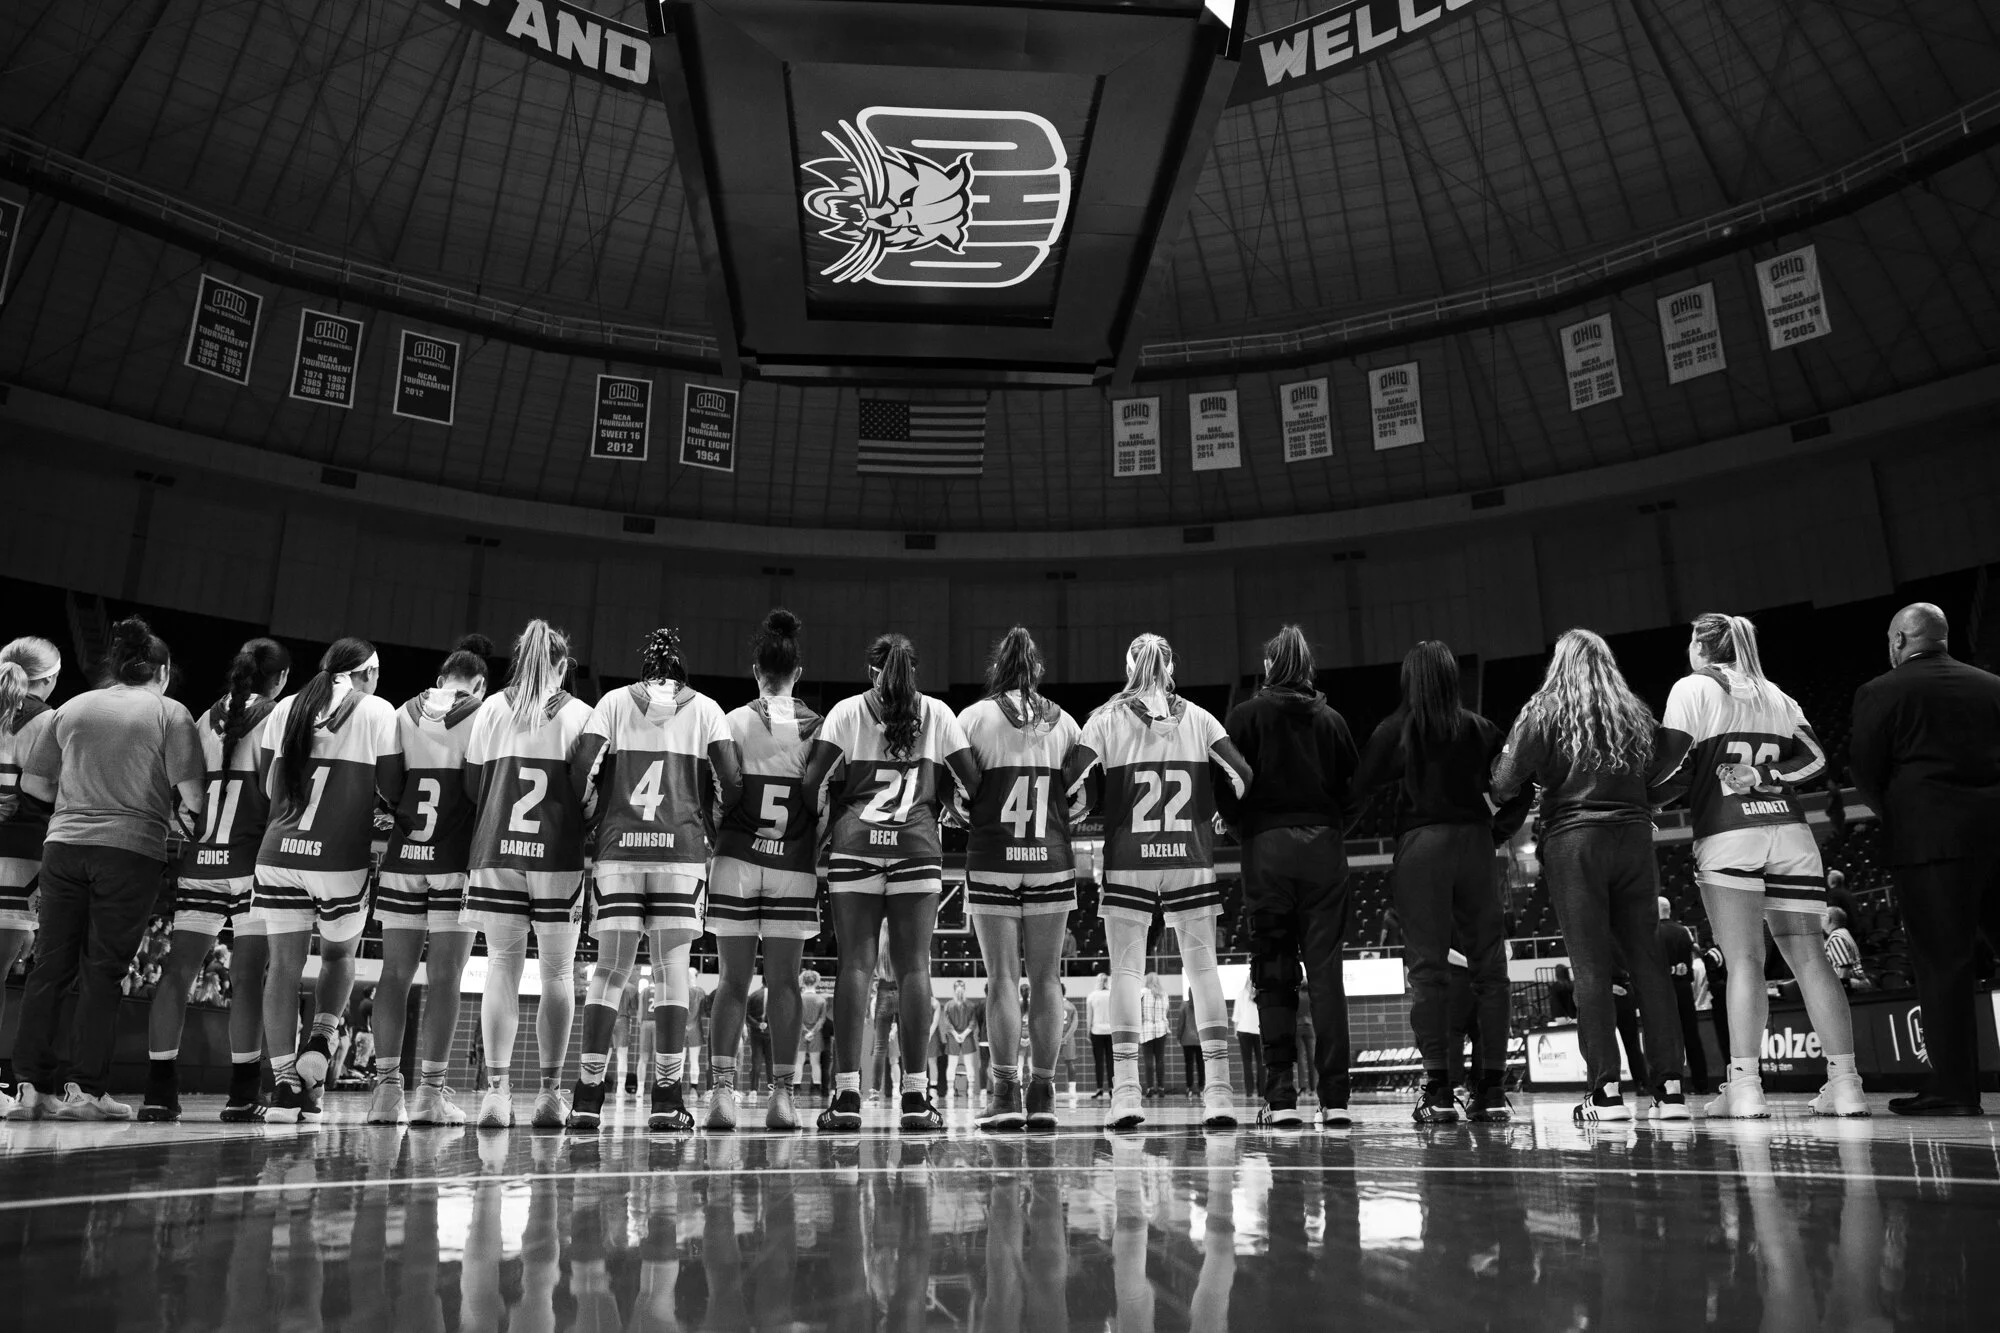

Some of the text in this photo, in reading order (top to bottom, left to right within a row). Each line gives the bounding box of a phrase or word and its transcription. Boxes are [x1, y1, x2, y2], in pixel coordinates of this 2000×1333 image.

[505, 0, 651, 85] AND
[1771, 258, 1804, 281] OHIO
[213, 289, 247, 316] OHIO
[1671, 295, 1701, 317] OHIO
[1773, 306, 1820, 327] SWEET 16
[200, 325, 248, 348] TOURNAMENT
[215, 324, 235, 336] NCAA
[315, 321, 348, 343] OHIO
[1573, 325, 1601, 345] OHIO
[1783, 322, 1816, 340] 2005
[318, 354, 337, 363] NCAA
[414, 341, 445, 363] OHIO
[198, 355, 240, 376] 1970 1972
[302, 357, 351, 373] TOURNAMENT
[304, 370, 322, 379] 1974
[418, 372, 437, 382] NCAA
[1381, 372, 1407, 389] OHIO
[403, 375, 450, 392] TOURNAMENT
[405, 387, 424, 397] 2012
[609, 383, 639, 401] OHIO
[697, 393, 725, 412] OHIO
[1292, 386, 1317, 403] OHIO
[1124, 404, 1149, 419] OHIO
[1201, 397, 1226, 413] OHIO
[600, 419, 643, 428] TOURNAMENT
[701, 422, 718, 430] NCAA
[601, 430, 640, 440] SWEET 16
[688, 426, 730, 439] TOURNAMENT
[1196, 432, 1234, 440] CHAMPIONS
[607, 442, 633, 453] 2012
[687, 437, 730, 450] ELITE EIGHT
[696, 450, 720, 462] 1964
[297, 766, 331, 831] 1
[629, 760, 665, 822] 4
[859, 766, 919, 823] 21
[508, 766, 549, 834] 2
[1000, 775, 1050, 839] 41
[1131, 769, 1192, 834] 22
[1741, 800, 1790, 816] GARNETT
[198, 779, 243, 844] 11
[406, 778, 441, 843] 3
[754, 783, 791, 840] 5
[618, 832, 675, 848] JOHNSON
[869, 829, 899, 846] BECK
[280, 837, 322, 857] HOOKS
[400, 844, 435, 861] BURKE
[500, 839, 545, 858] BARKER
[1005, 846, 1048, 861] BURRIS
[1141, 842, 1187, 858] BAZELAK
[196, 850, 229, 865] GUICE
[1760, 1027, 1827, 1059] olze
